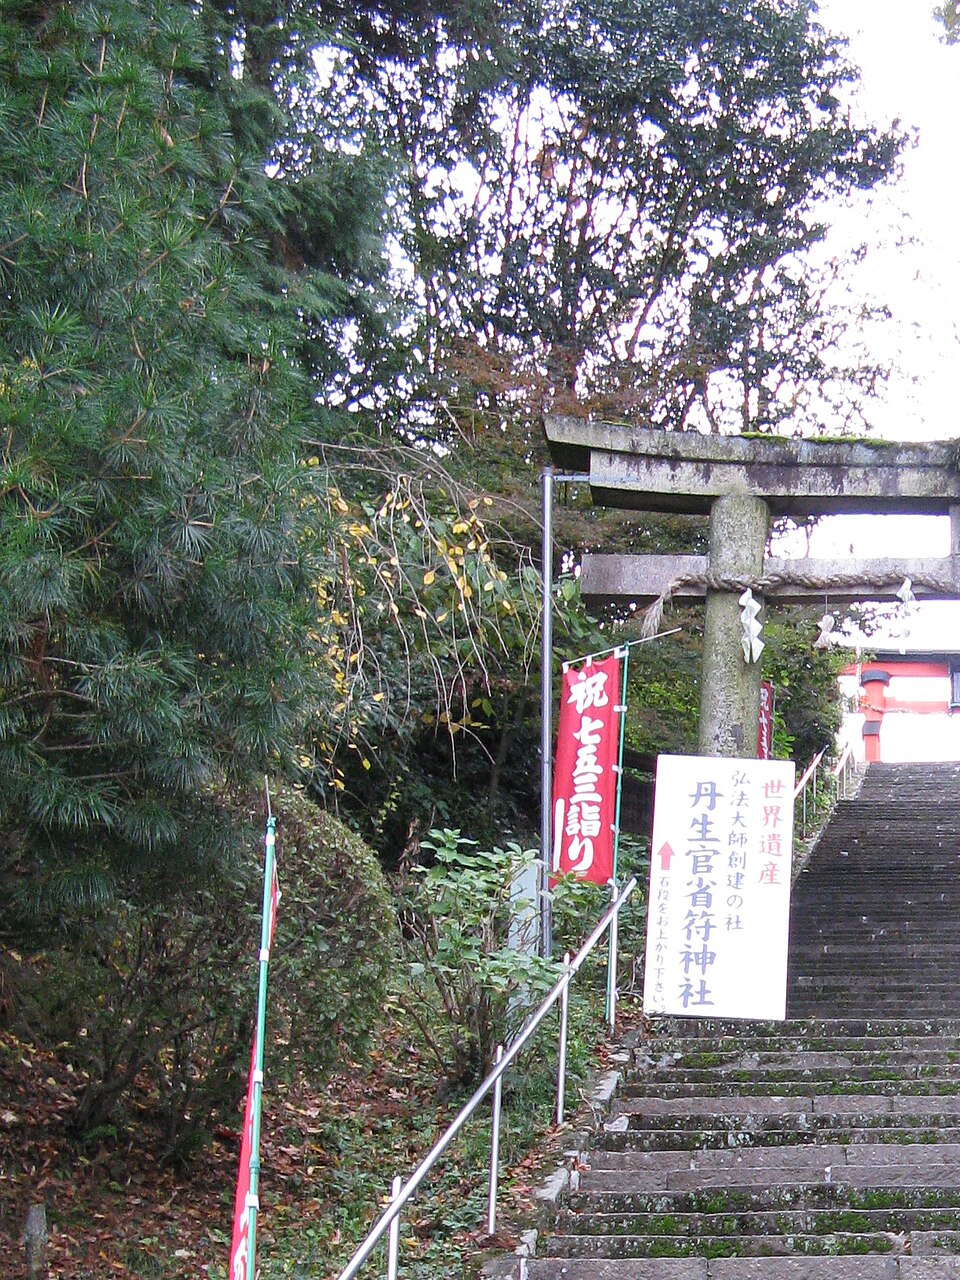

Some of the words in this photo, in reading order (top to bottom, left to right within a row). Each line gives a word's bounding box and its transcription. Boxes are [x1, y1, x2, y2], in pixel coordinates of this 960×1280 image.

[677, 781, 724, 1009] 丹生官省符神社
[724, 770, 751, 931] 弘法大師創建の社
[757, 779, 786, 885] 世界遺産
